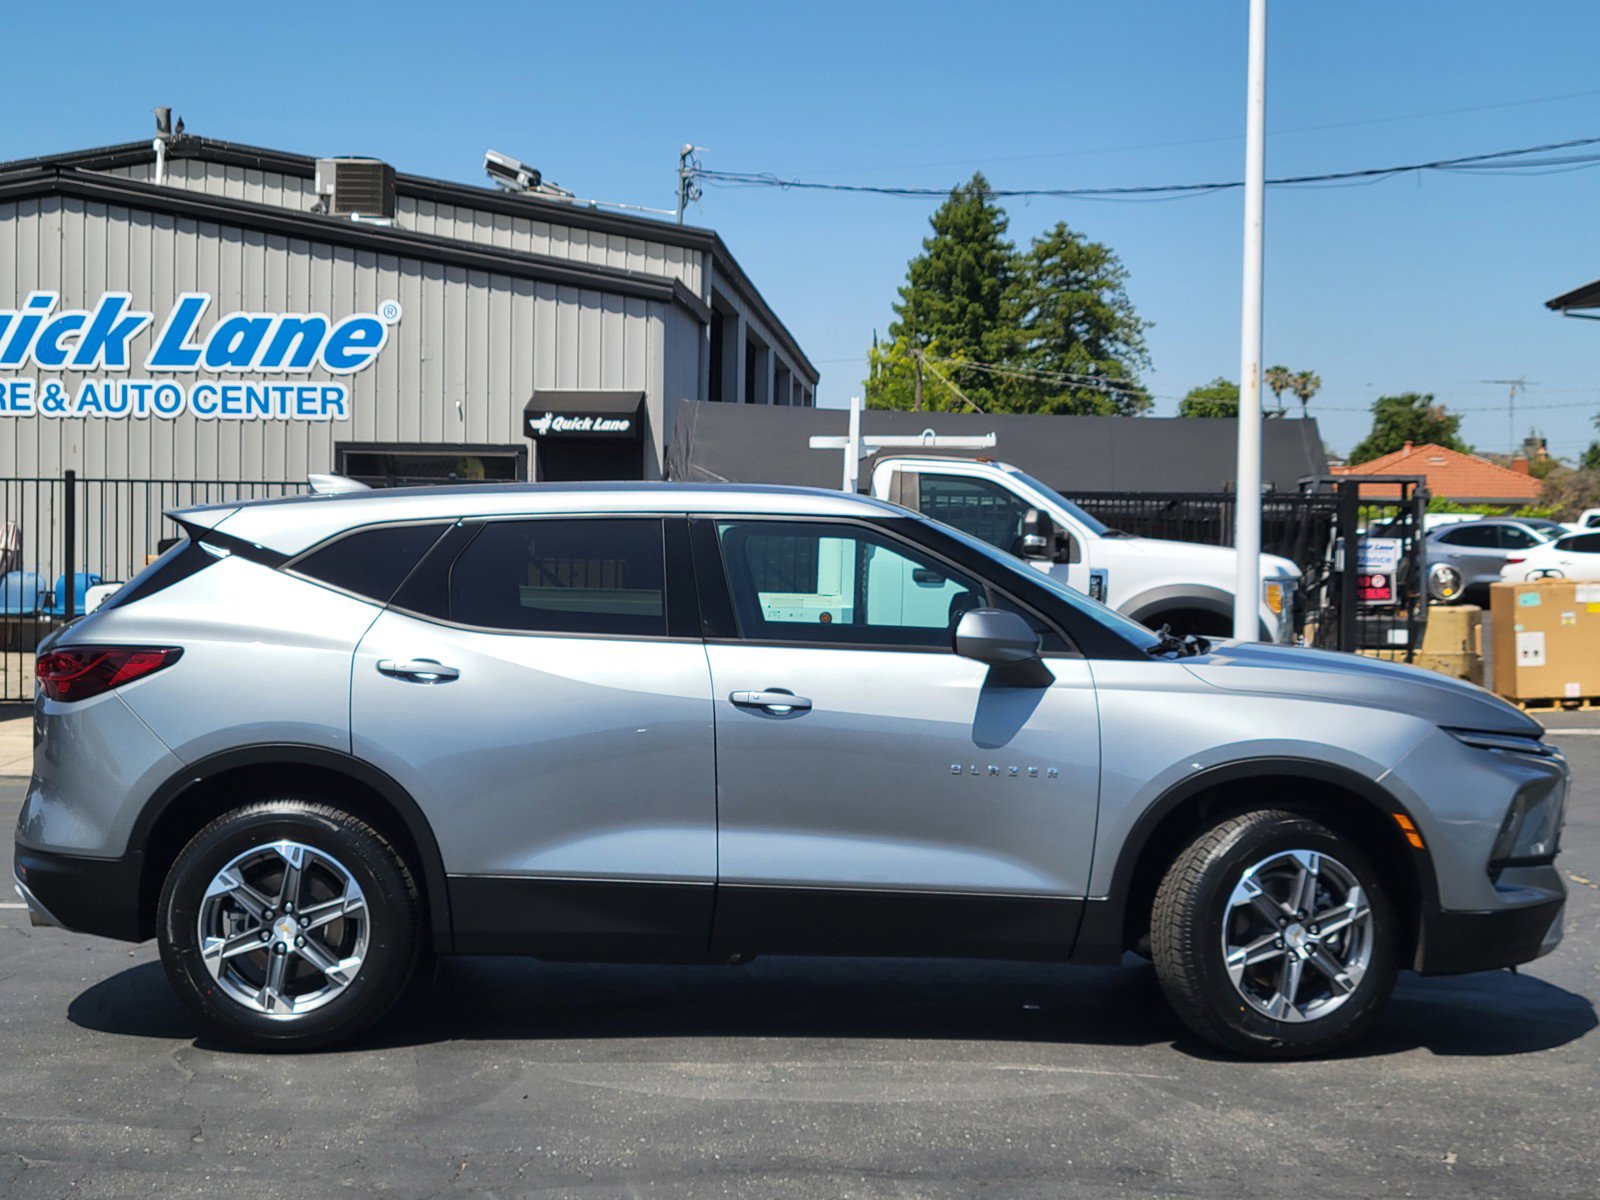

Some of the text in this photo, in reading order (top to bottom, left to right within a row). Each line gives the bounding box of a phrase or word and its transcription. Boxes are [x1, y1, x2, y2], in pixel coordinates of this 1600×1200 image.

[150, 297, 385, 369] Lane
[42, 383, 67, 413] &
[76, 384, 182, 415] AUTO
[192, 385, 345, 416] CENTER
[551, 416, 630, 432] Quick Lane
[950, 764, 1060, 779] BLAZER
